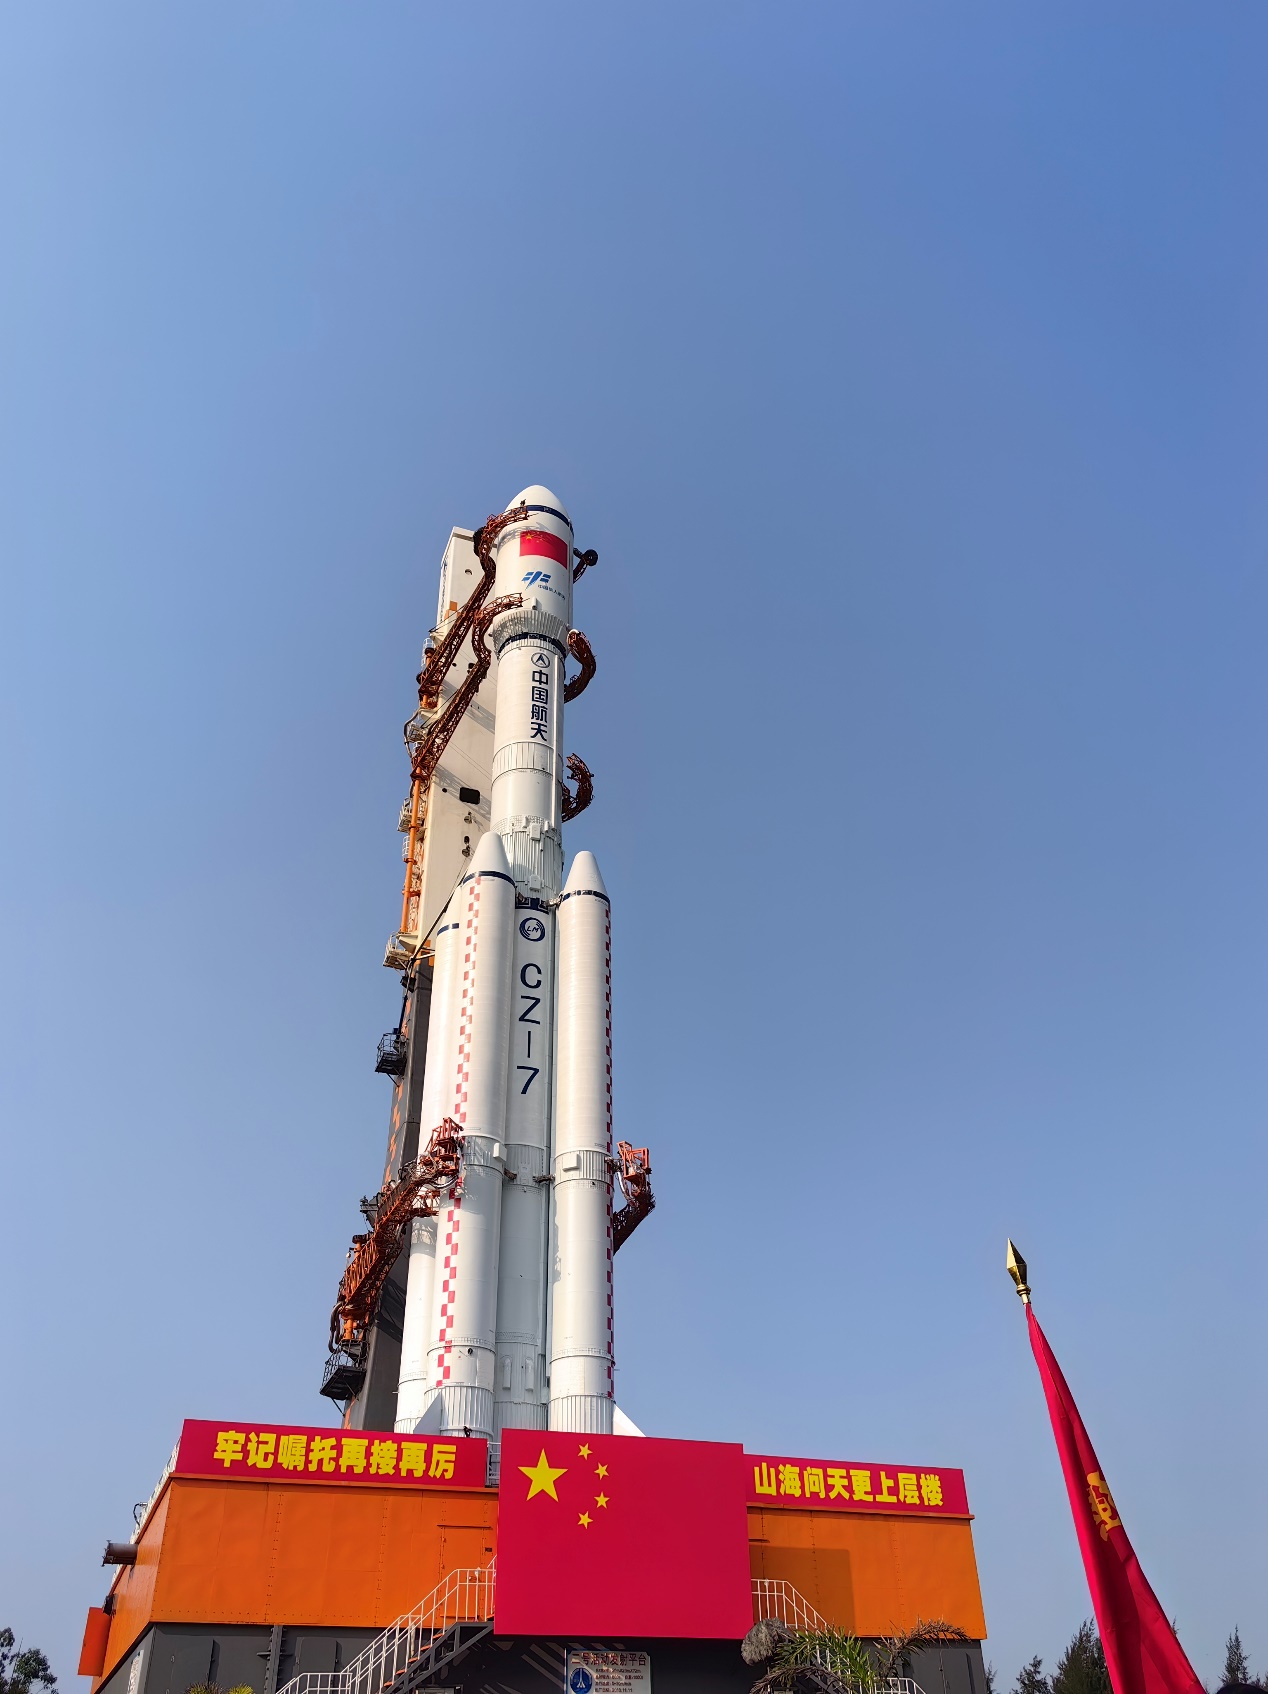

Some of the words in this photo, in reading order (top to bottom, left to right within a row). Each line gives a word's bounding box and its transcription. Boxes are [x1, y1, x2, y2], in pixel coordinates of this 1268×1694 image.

[530, 669, 549, 742] 中国航天
[213, 1430, 457, 1479] 牢记嘱托再接再厉
[753, 1462, 944, 1507] 山海问天更上层楼
[571, 1652, 647, 1666] 二号活动发射平台
